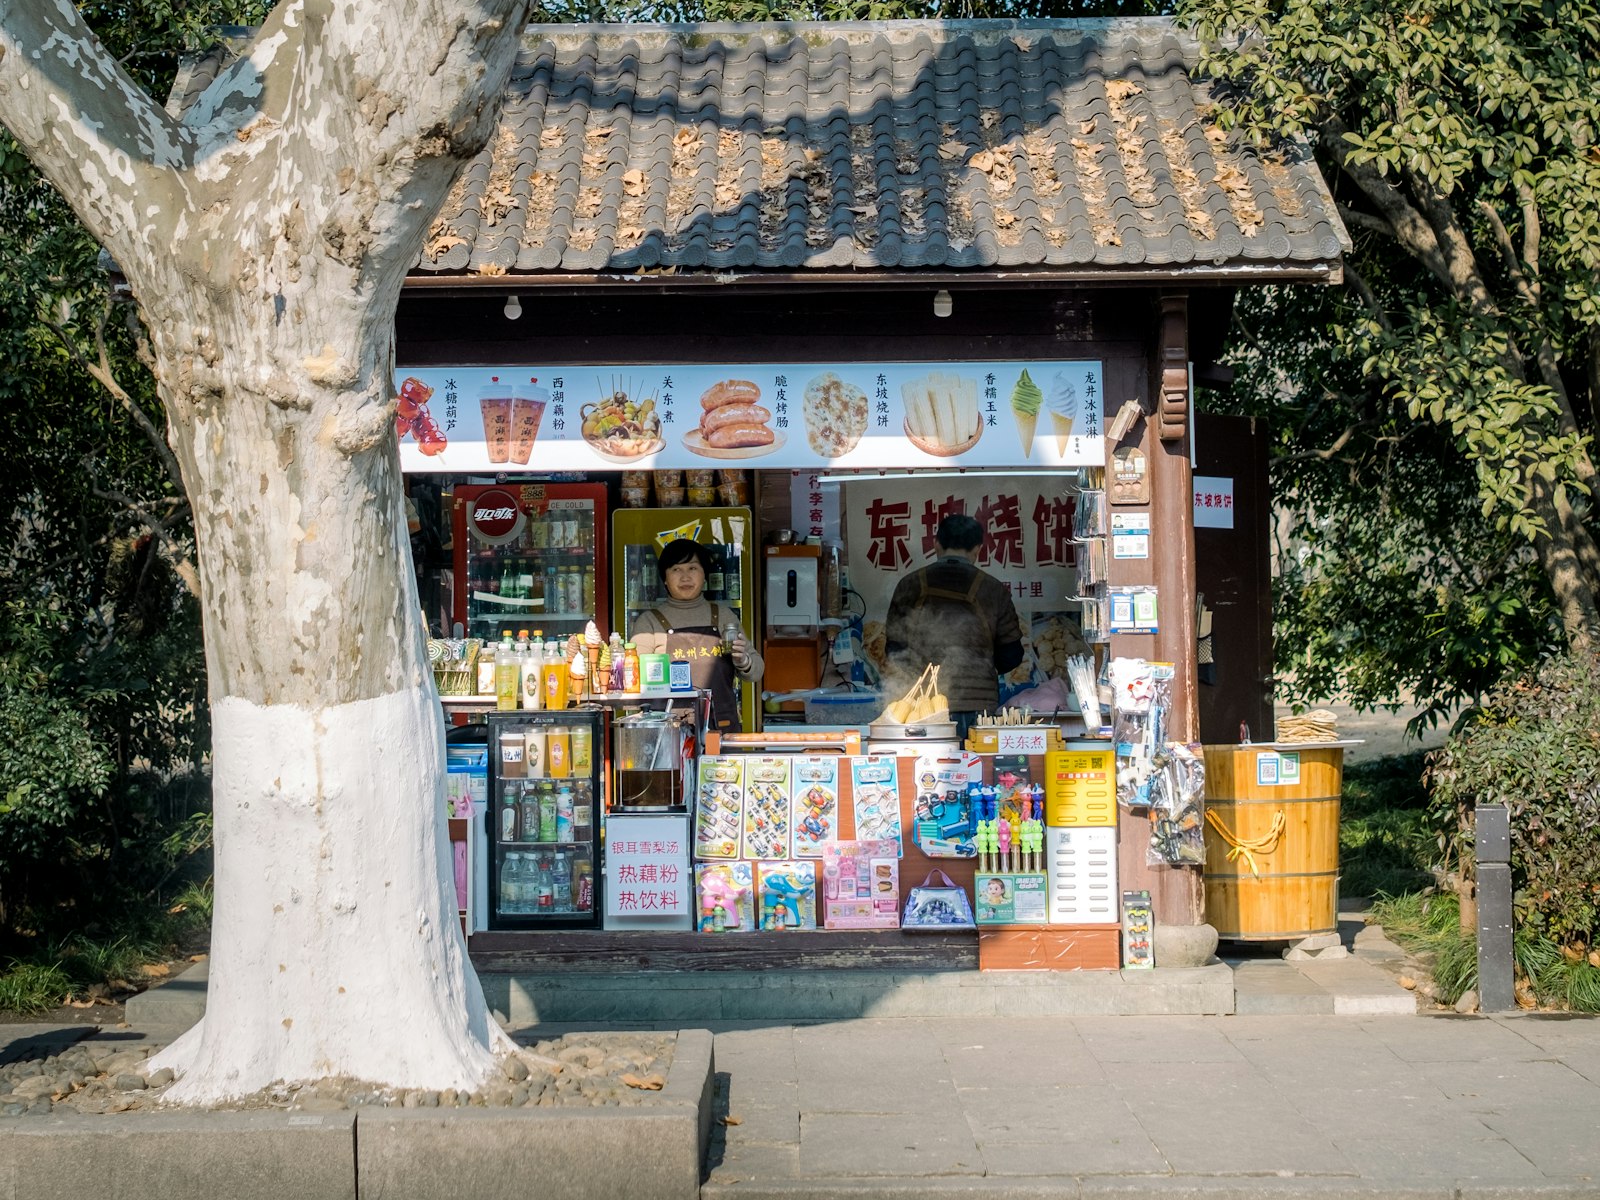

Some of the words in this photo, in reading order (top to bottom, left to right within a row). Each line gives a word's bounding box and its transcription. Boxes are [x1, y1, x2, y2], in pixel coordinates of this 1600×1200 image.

[445, 378, 458, 432] 冰糖葫芦
[552, 377, 565, 431] 西湖藕粉
[662, 376, 675, 424] 关东煮
[775, 375, 788, 428] 脆皮烤肠
[876, 373, 889, 427] 东坡烧饼
[984, 373, 998, 427] 香糯玉米
[1085, 371, 1098, 439] 龙井冰淇淋
[474, 507, 516, 521] 可口可乐
[1194, 492, 1232, 508] 东坡烧饼
[673, 645, 723, 660] 杭州文创
[1001, 735, 1044, 749] 关东煮
[611, 841, 679, 855] 银耳雪梨汤
[618, 863, 679, 884] 热藕粉
[618, 889, 680, 911] 热饮料
